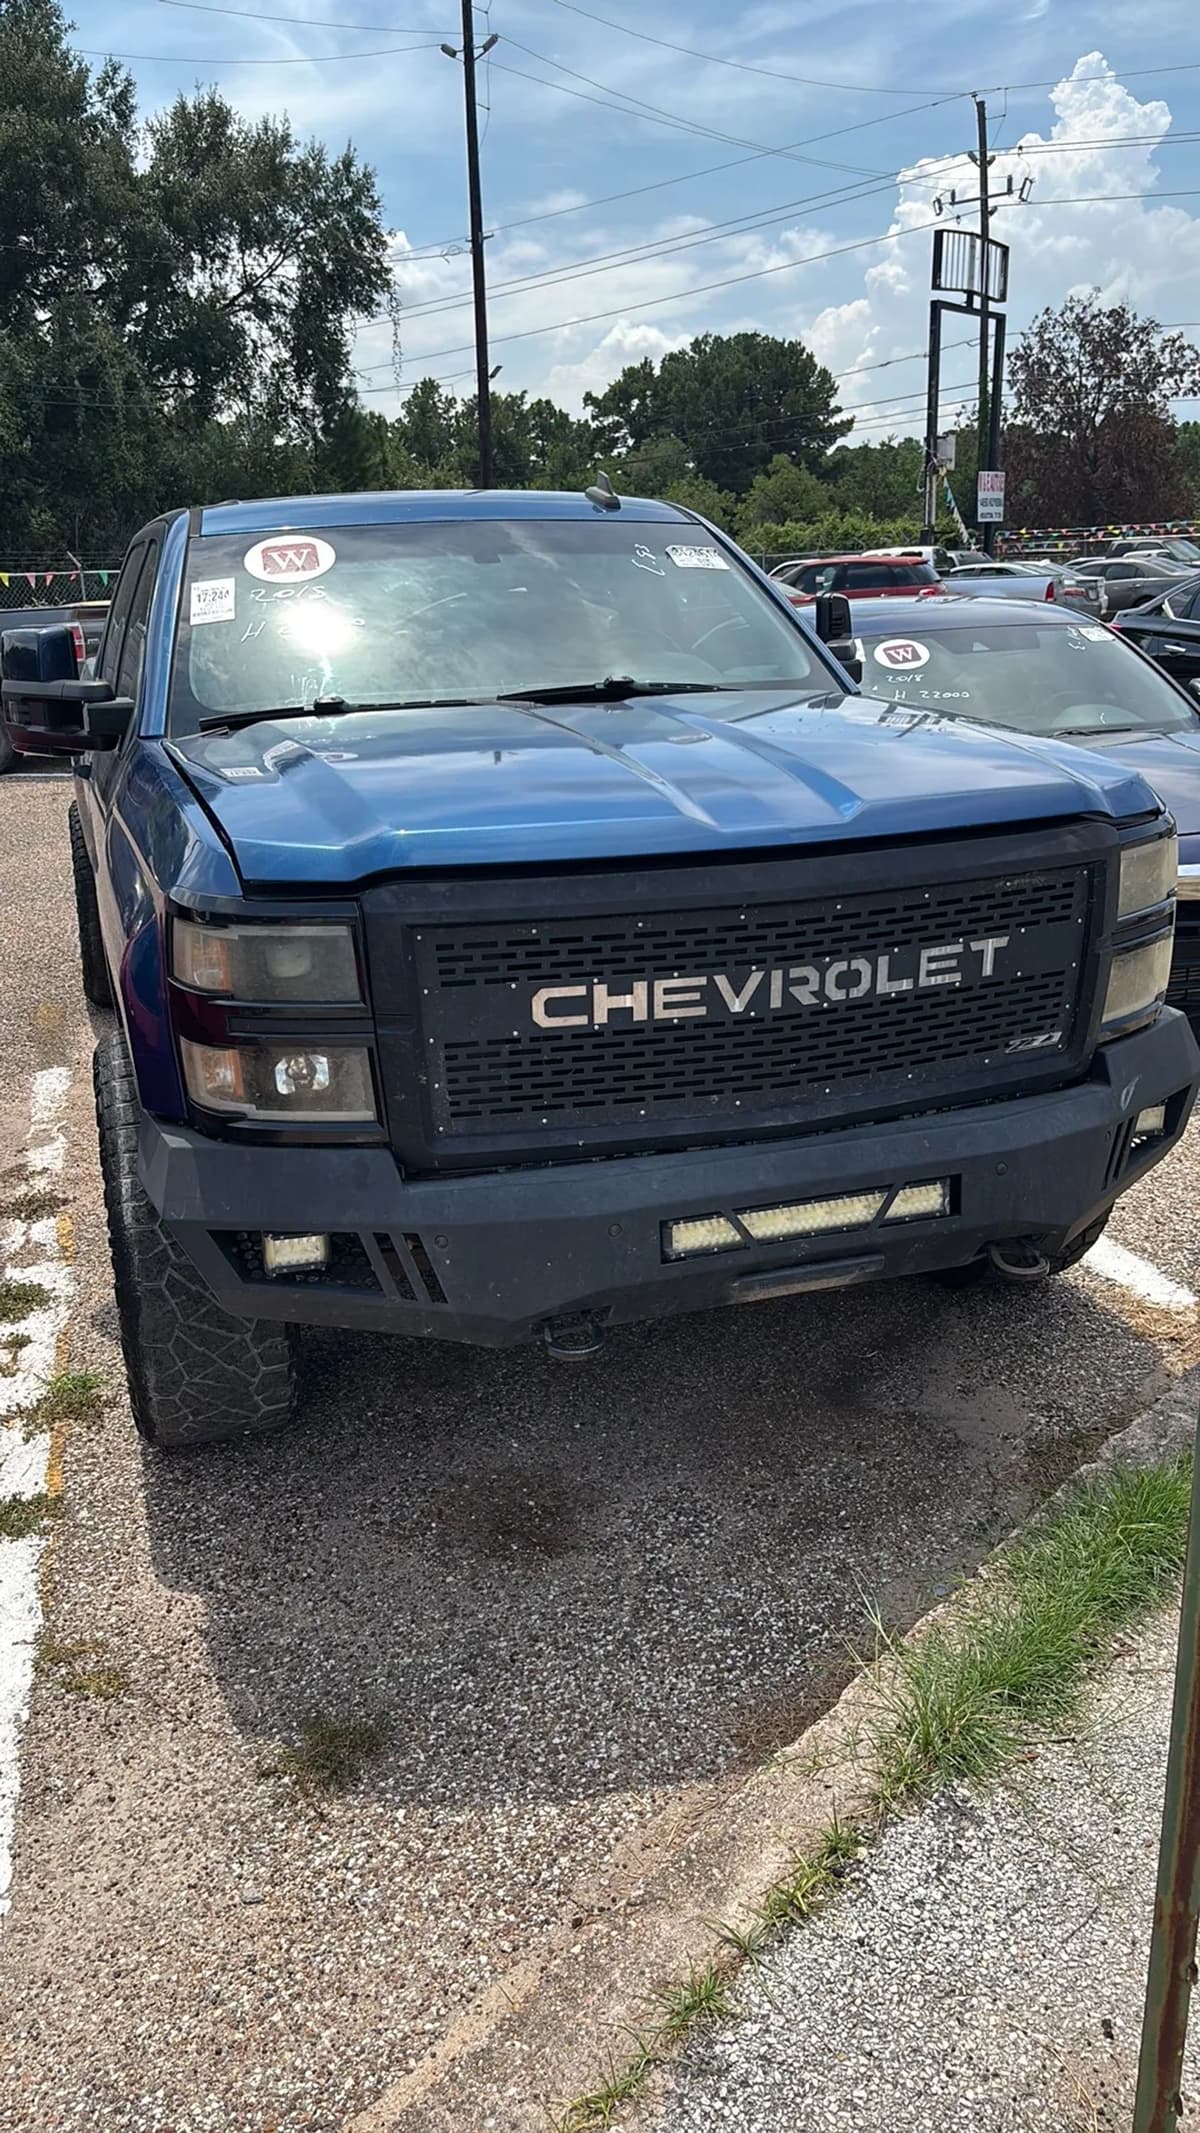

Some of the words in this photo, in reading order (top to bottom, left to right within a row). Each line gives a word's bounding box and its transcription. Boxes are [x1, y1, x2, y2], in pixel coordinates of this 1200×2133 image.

[266, 549, 313, 571] W
[250, 585, 327, 602] 2015
[887, 647, 913, 662] W
[885, 674, 924, 683] 2018
[919, 690, 970, 699] 22000
[531, 936, 1009, 1029] CHEVROLET
